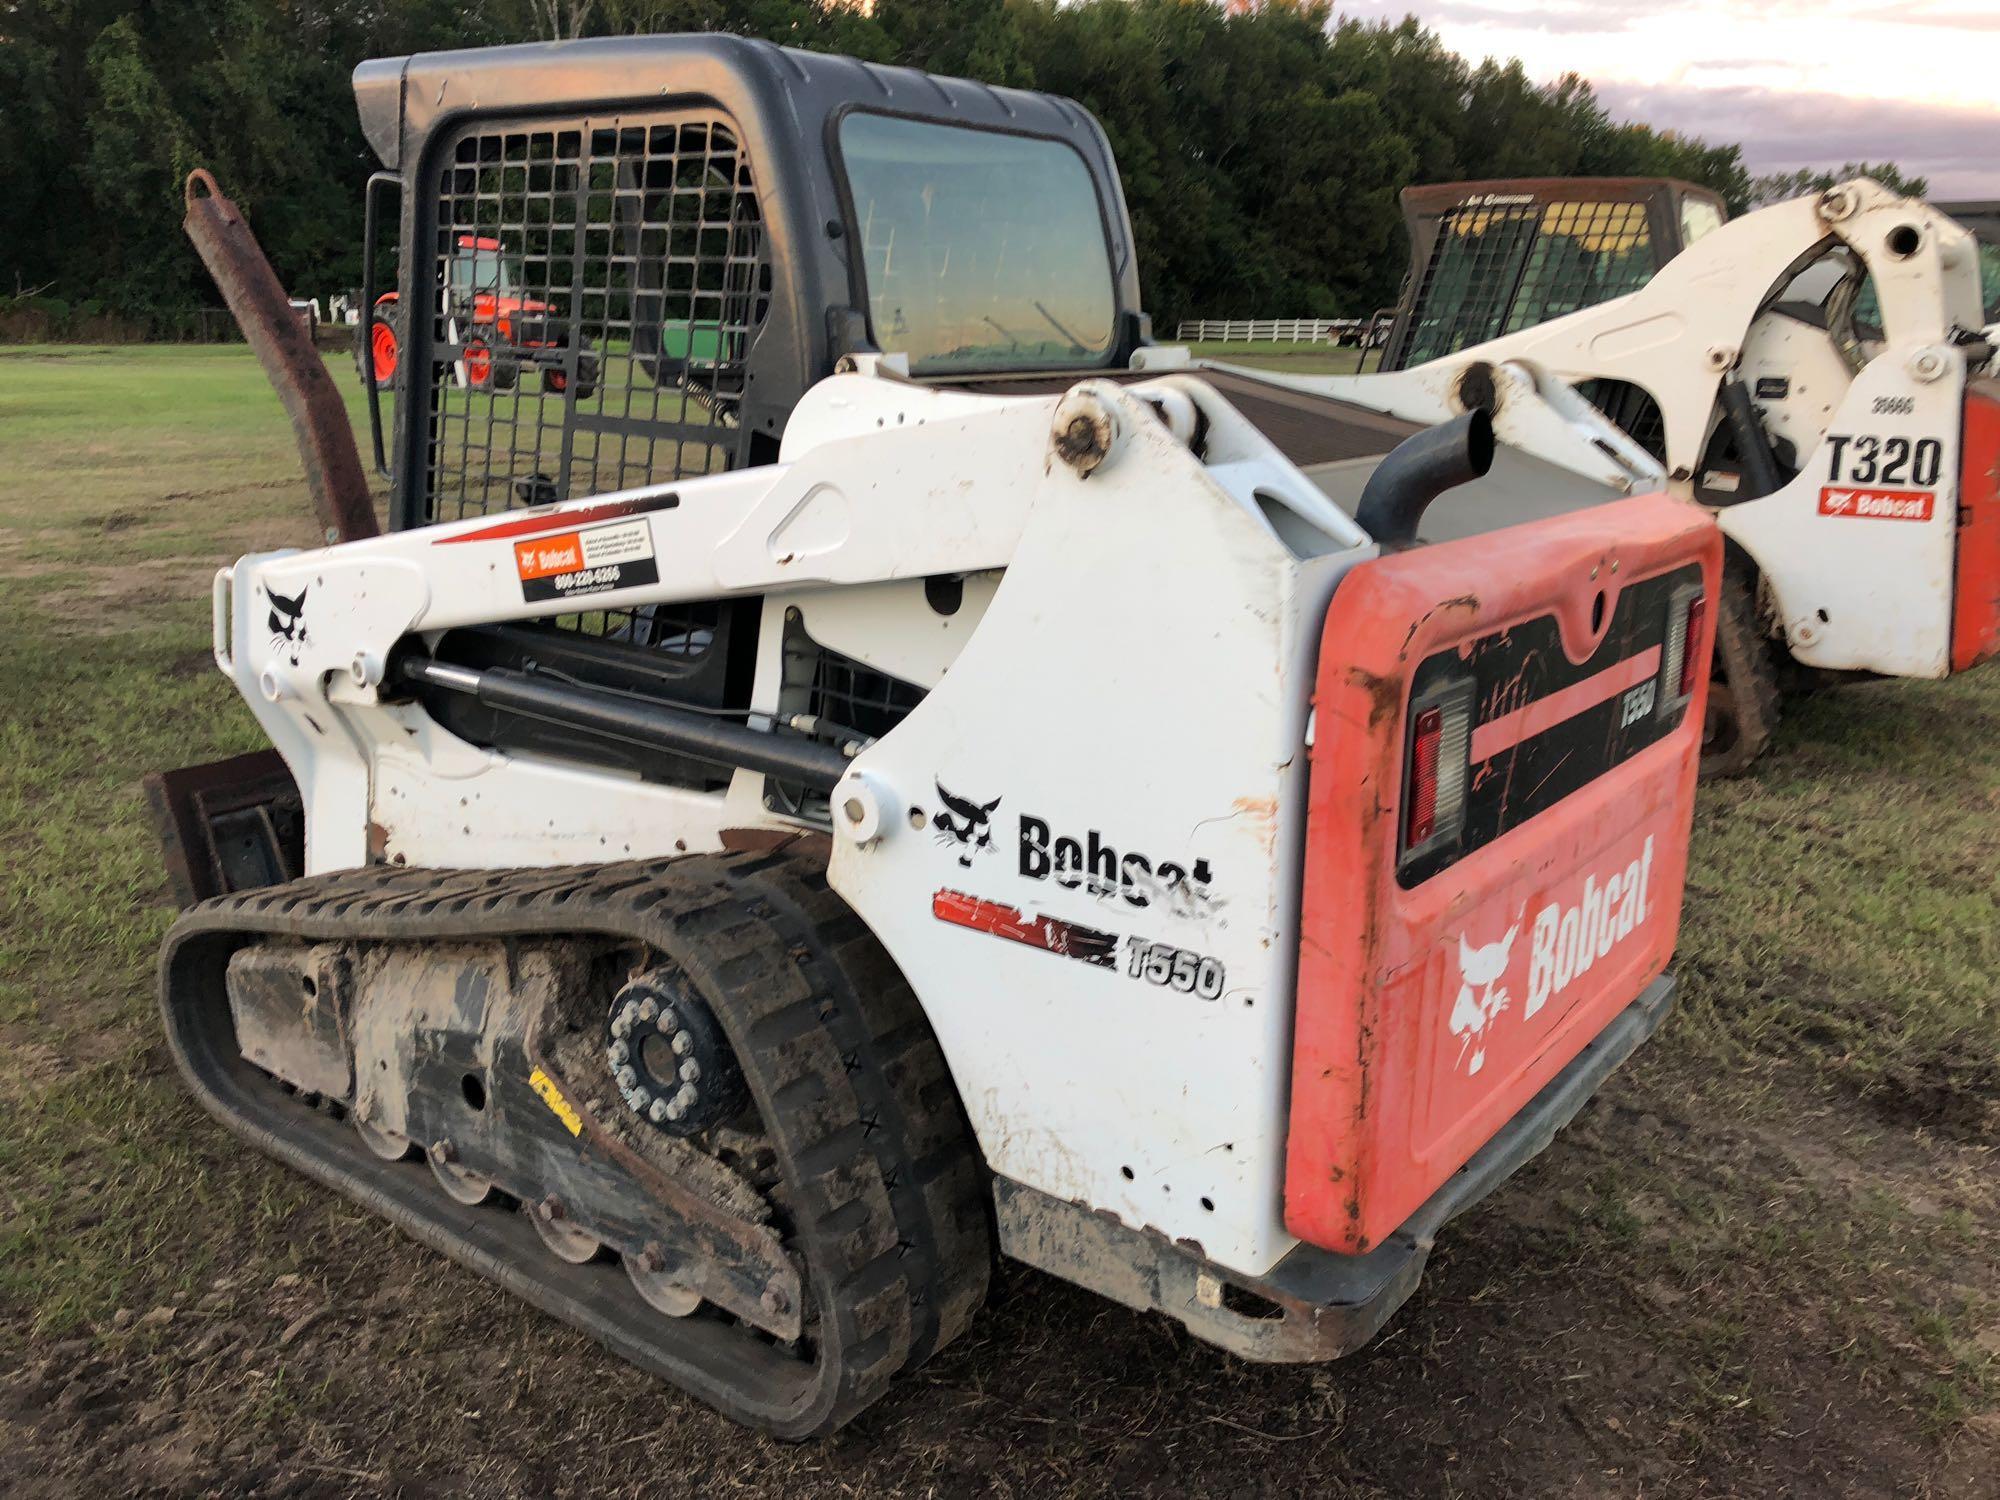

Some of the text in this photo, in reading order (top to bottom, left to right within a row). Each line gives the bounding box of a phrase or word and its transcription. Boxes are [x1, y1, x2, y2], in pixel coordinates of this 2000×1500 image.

[1826, 436, 1942, 485] T320
[1856, 495, 1924, 518] Bobcat
[538, 547, 577, 570] Bobcat
[1621, 681, 1656, 729] T550
[1523, 834, 1655, 1021] Bobcat
[1127, 935, 1225, 1000] T550
